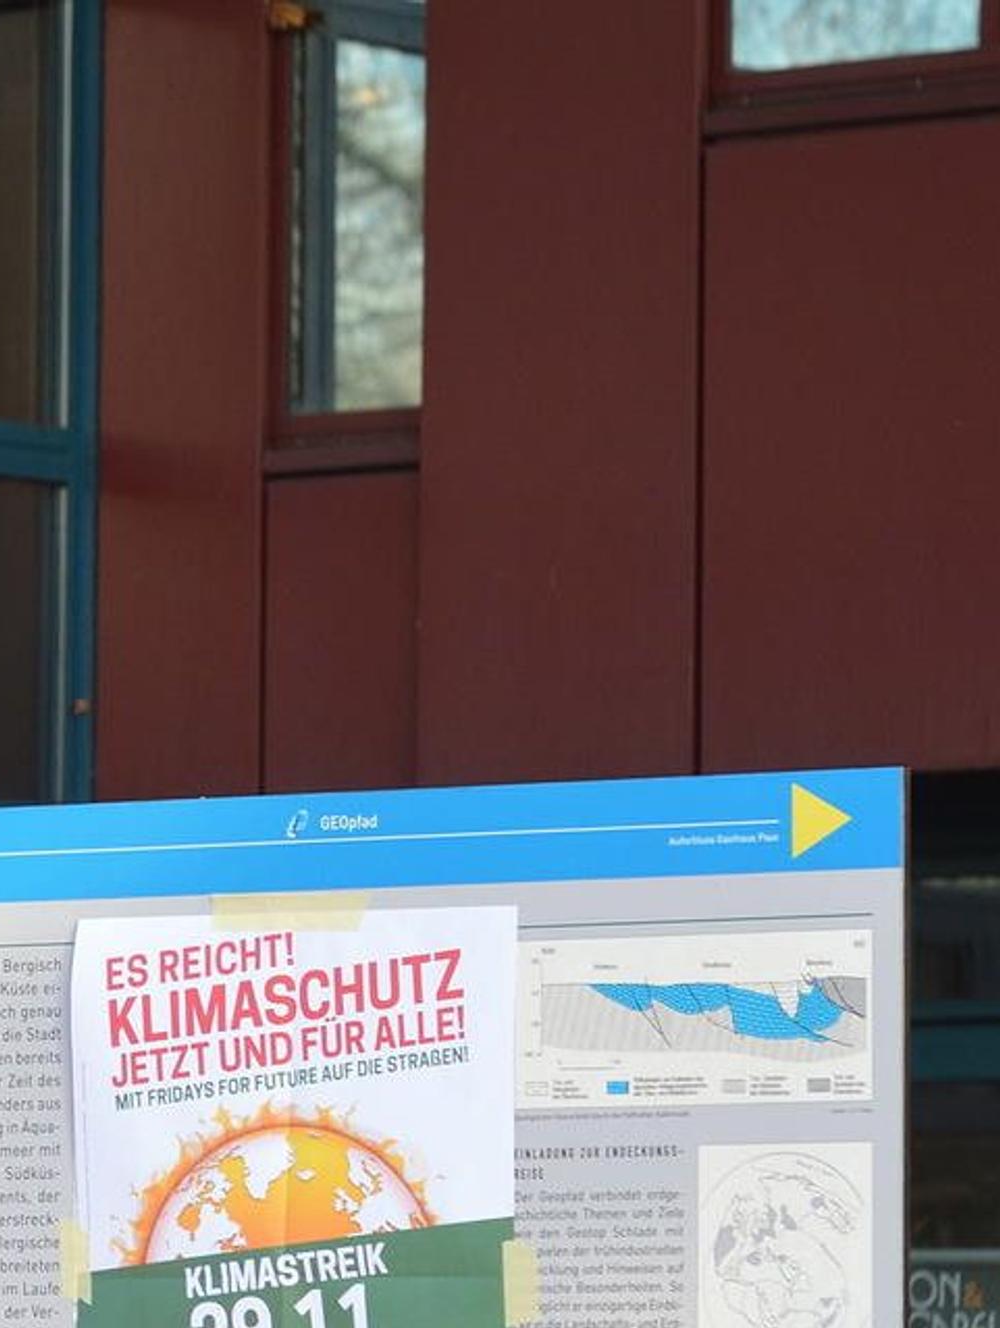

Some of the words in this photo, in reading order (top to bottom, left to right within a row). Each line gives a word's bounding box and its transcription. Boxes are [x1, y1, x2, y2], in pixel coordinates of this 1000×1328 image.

[318, 814, 379, 832] GEOpfad
[2, 959, 62, 976] Bergisch
[106, 954, 149, 990] ES
[160, 932, 295, 983] REICHT!
[109, 948, 465, 1047] KLIMASCHUTZ
[20, 1008, 62, 1021] genau
[1, 1029, 23, 1042] die
[26, 1028, 62, 1041] Stadt
[112, 1041, 212, 1088] JETZT
[219, 1032, 293, 1073] UND
[302, 1015, 366, 1062] FÜR
[374, 1005, 466, 1052] ALLE!
[15, 1051, 62, 1065] bereits
[7, 1075, 34, 1088] Zeit
[37, 1074, 61, 1087] des
[115, 1091, 144, 1112] MIT
[148, 1081, 215, 1107] FRIDAYS
[218, 1075, 250, 1096] FOR
[255, 1066, 318, 1092] FUTURE
[322, 1062, 355, 1082] AUF
[358, 1057, 383, 1076] DIE
[37, 1100, 61, 1110] aus
[38, 1143, 61, 1157] mit
[37, 1190, 61, 1203] der
[0, 1259, 61, 1272] breiteten
[185, 1243, 389, 1298] KLIMASTREIK
[22, 1283, 61, 1296] Laufe
